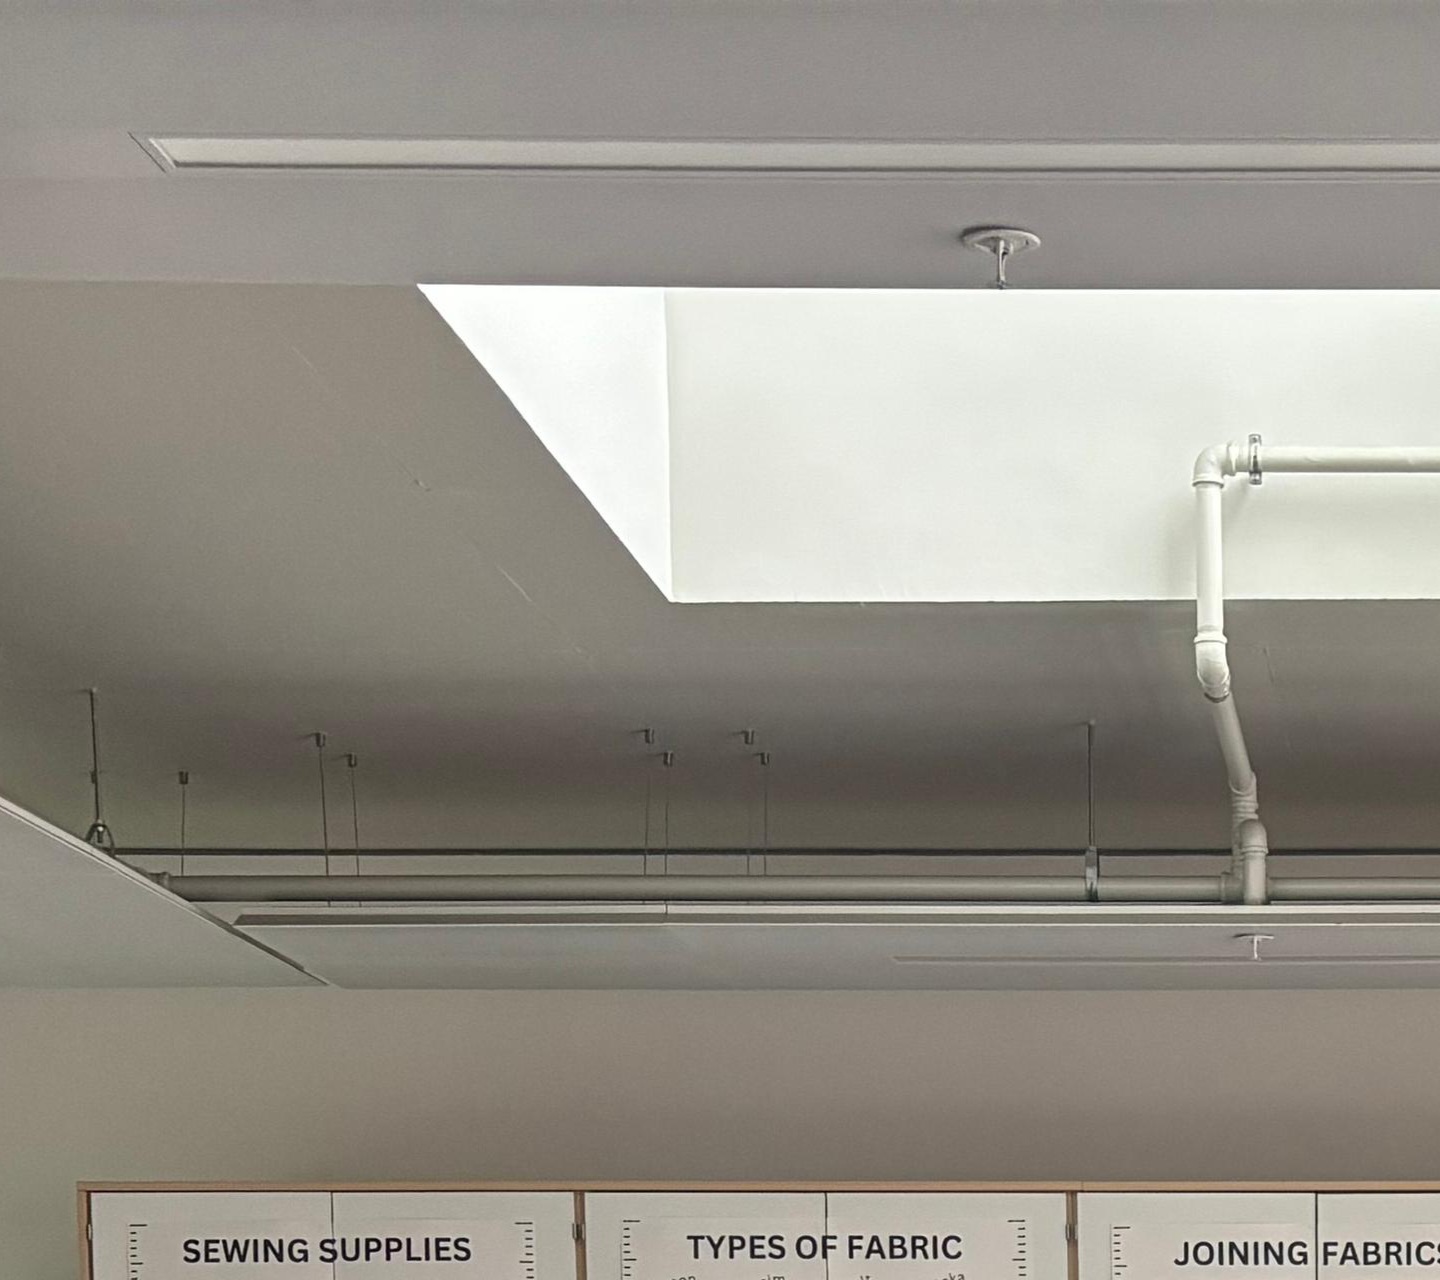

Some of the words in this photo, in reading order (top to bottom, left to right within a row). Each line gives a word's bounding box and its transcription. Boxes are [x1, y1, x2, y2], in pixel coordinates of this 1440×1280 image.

[182, 1238, 309, 1263] SEWING
[318, 1236, 472, 1263] SUPPLIES
[687, 1235, 786, 1260] TYPES
[795, 1235, 838, 1260] OF
[847, 1235, 963, 1260] FABRIC
[1174, 1241, 1309, 1266] JOINING
